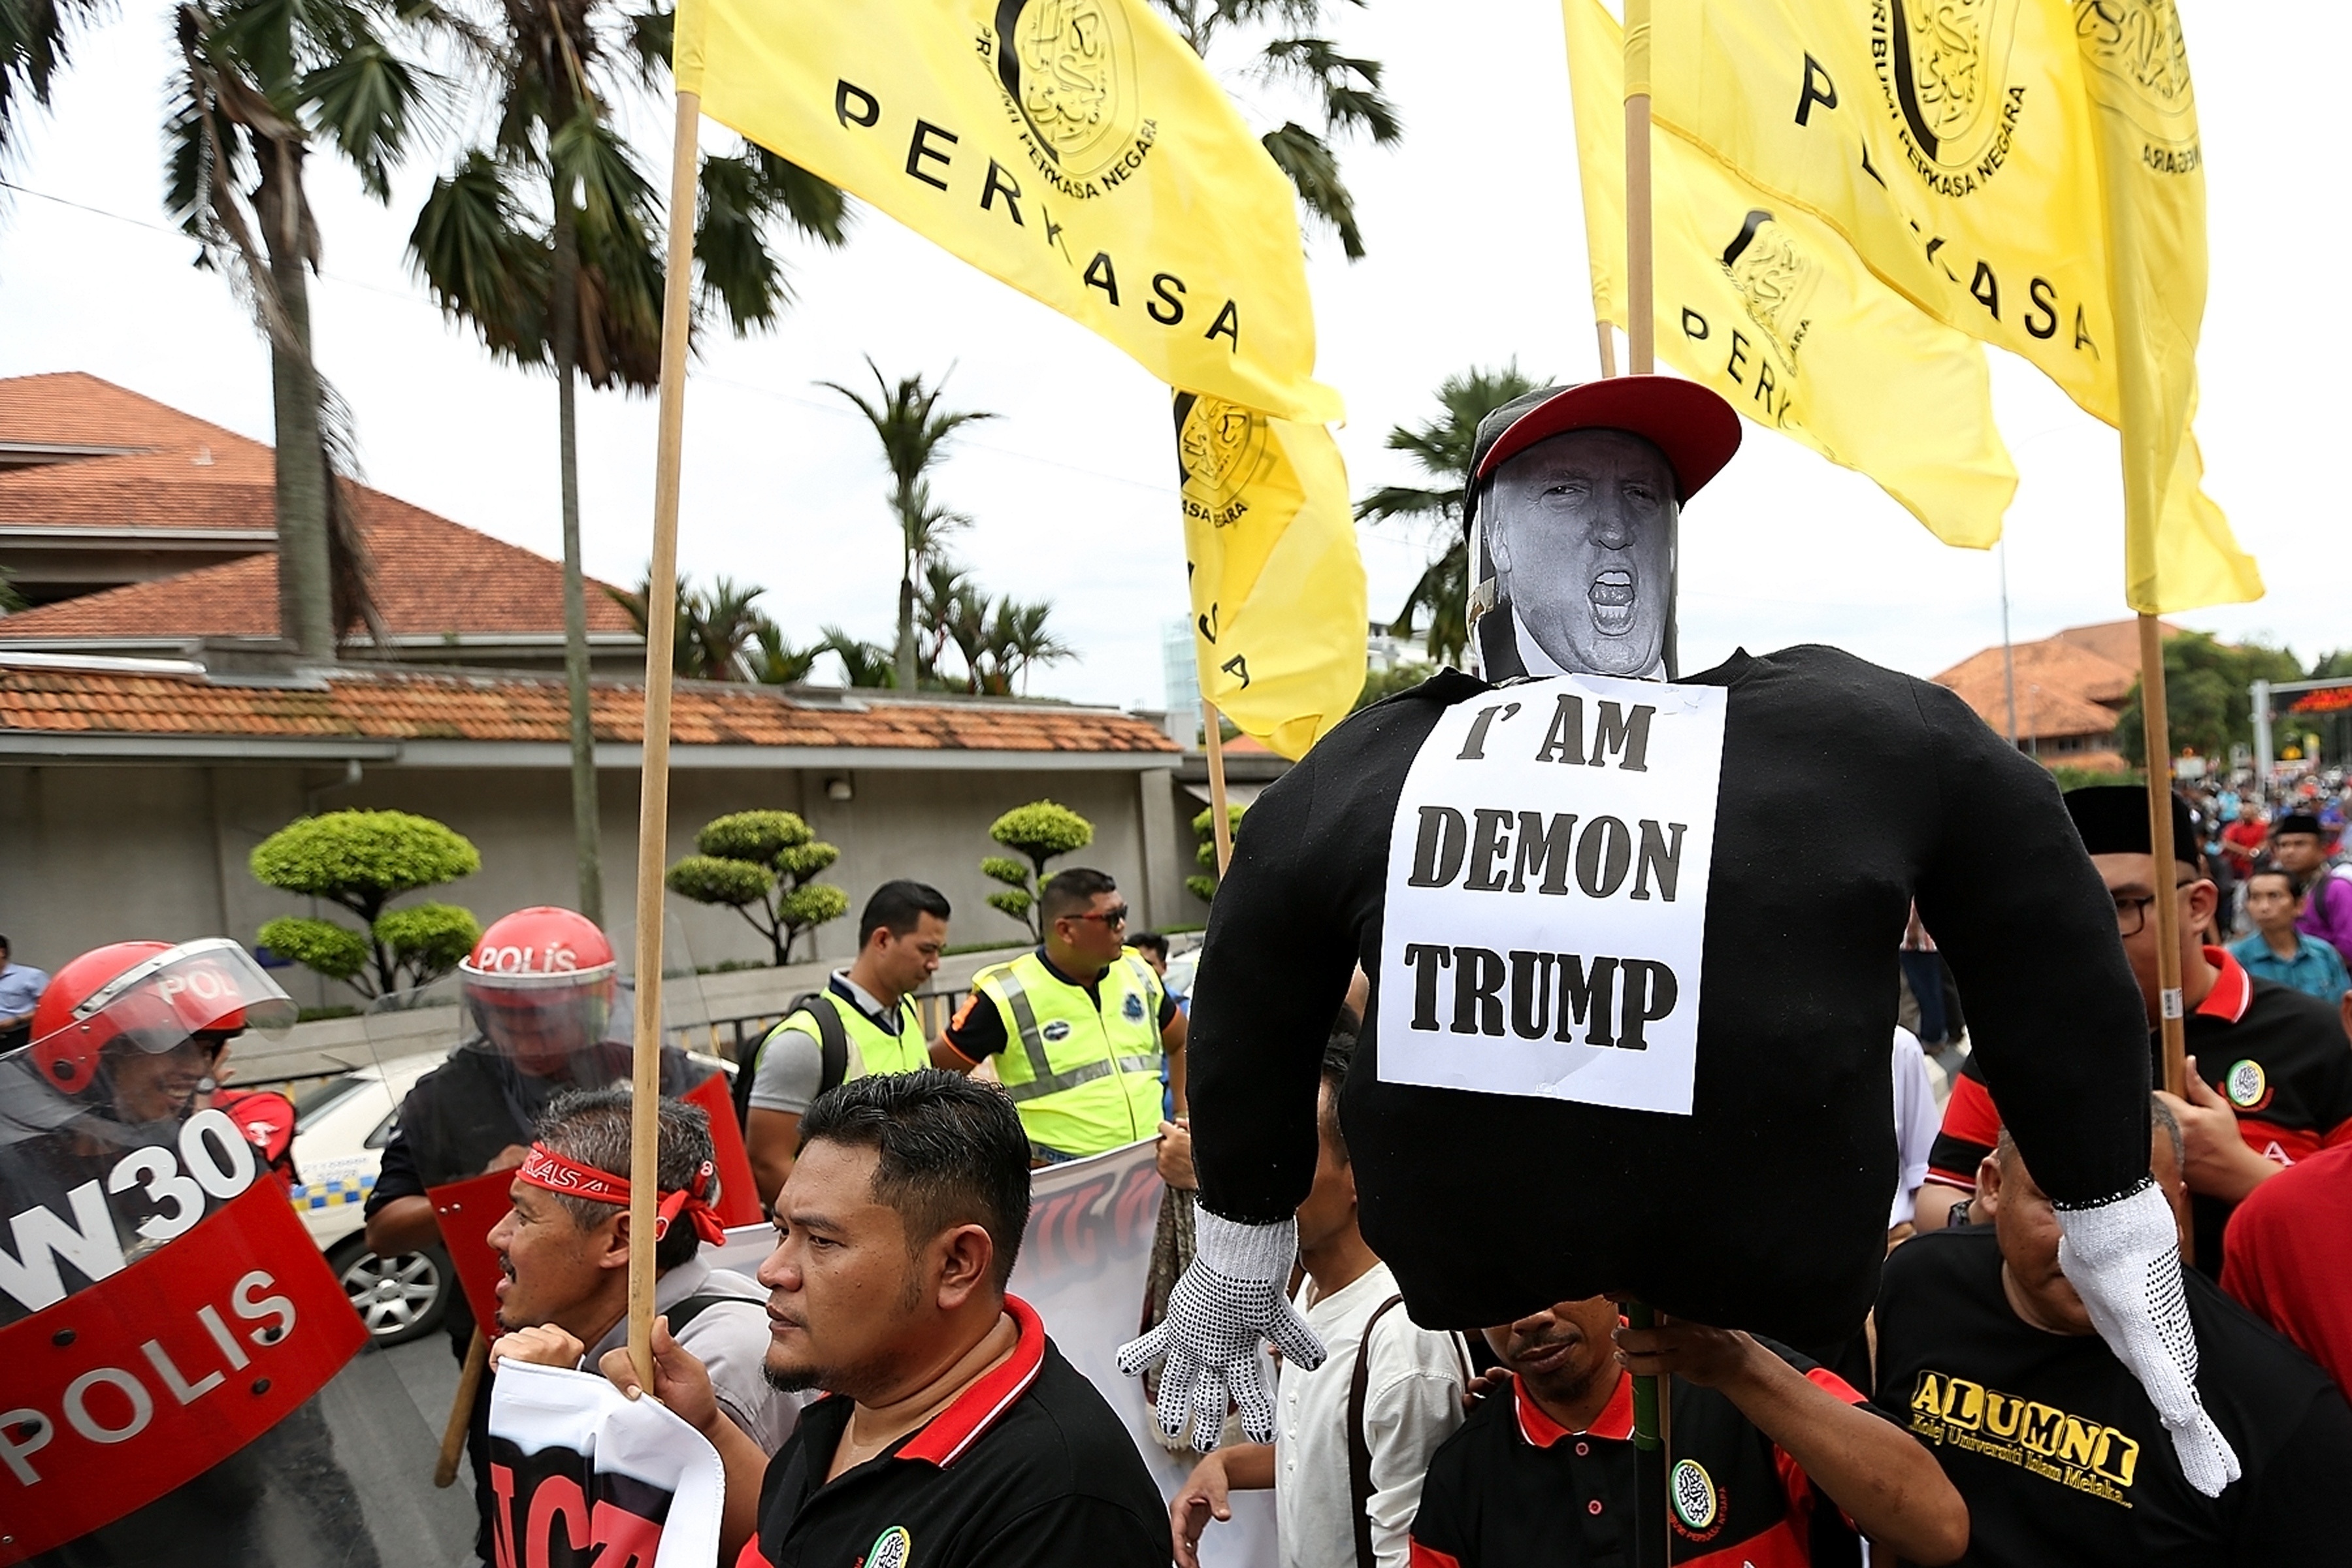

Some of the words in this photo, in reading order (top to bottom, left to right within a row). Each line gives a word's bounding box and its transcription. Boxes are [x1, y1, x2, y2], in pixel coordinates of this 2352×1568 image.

[1019, 133, 1100, 199] PERKASA
[1101, 118, 1158, 191] NEGARA
[1899, 129, 1978, 198] PERKASA
[1976, 86, 2026, 184] NEGARA
[835, 78, 1239, 353] PERKASA
[1795, 50, 2100, 361] PKASA
[1682, 304, 1793, 431] PERK
[1456, 702, 1521, 760] I'
[1535, 693, 1656, 772] AM
[1407, 806, 1688, 902] DEMON
[1404, 943, 1678, 1051] TRUMP
[0, 1109, 257, 1313] W30
[0, 1269, 297, 1486] POLIS
[1912, 1369, 2140, 1488] ALUMNI
[1947, 1425, 2023, 1467] Universiti
